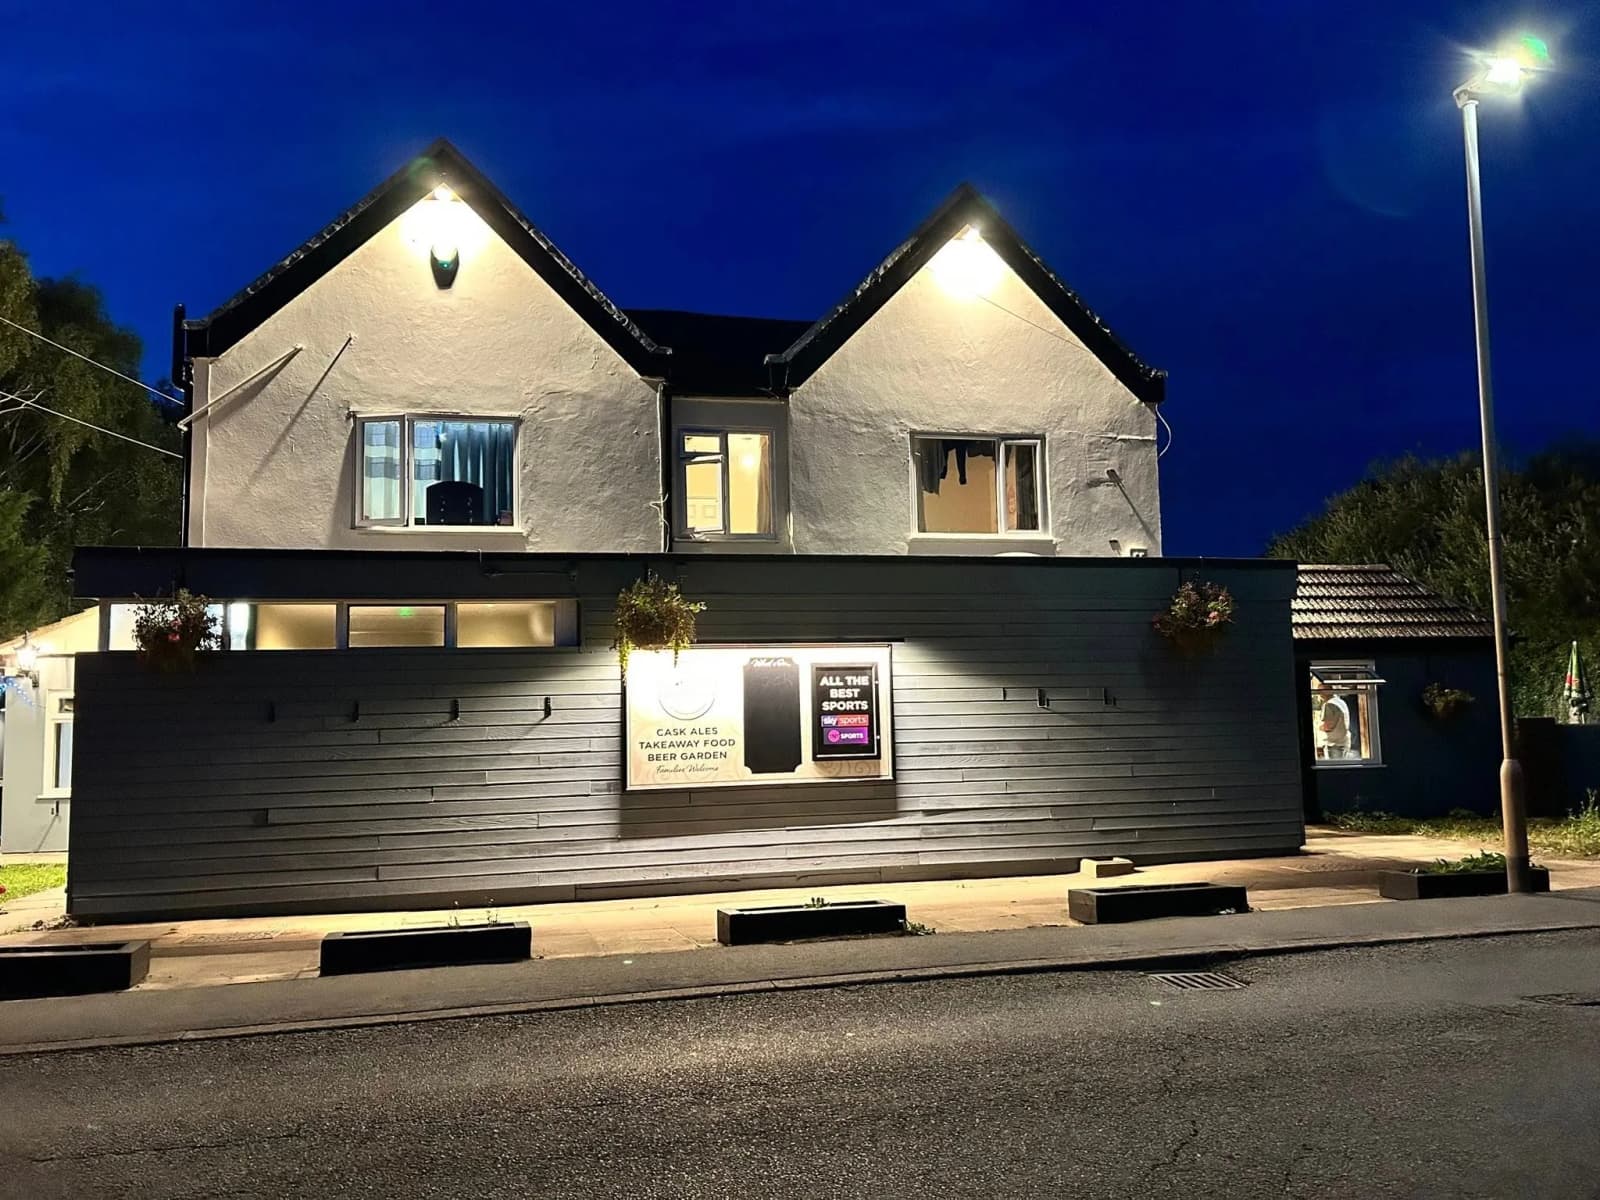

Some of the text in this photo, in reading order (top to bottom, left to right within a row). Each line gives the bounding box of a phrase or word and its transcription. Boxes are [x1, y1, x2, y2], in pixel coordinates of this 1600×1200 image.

[820, 675, 869, 686] ALL THE
[830, 688, 860, 698] BEST
[822, 701, 868, 711] SPORTS
[823, 716, 866, 727] sky sports
[656, 727, 718, 737] CASK ALES
[639, 738, 736, 750] TAKEAWAY FOOD
[647, 751, 728, 762] BEER GARDEN
